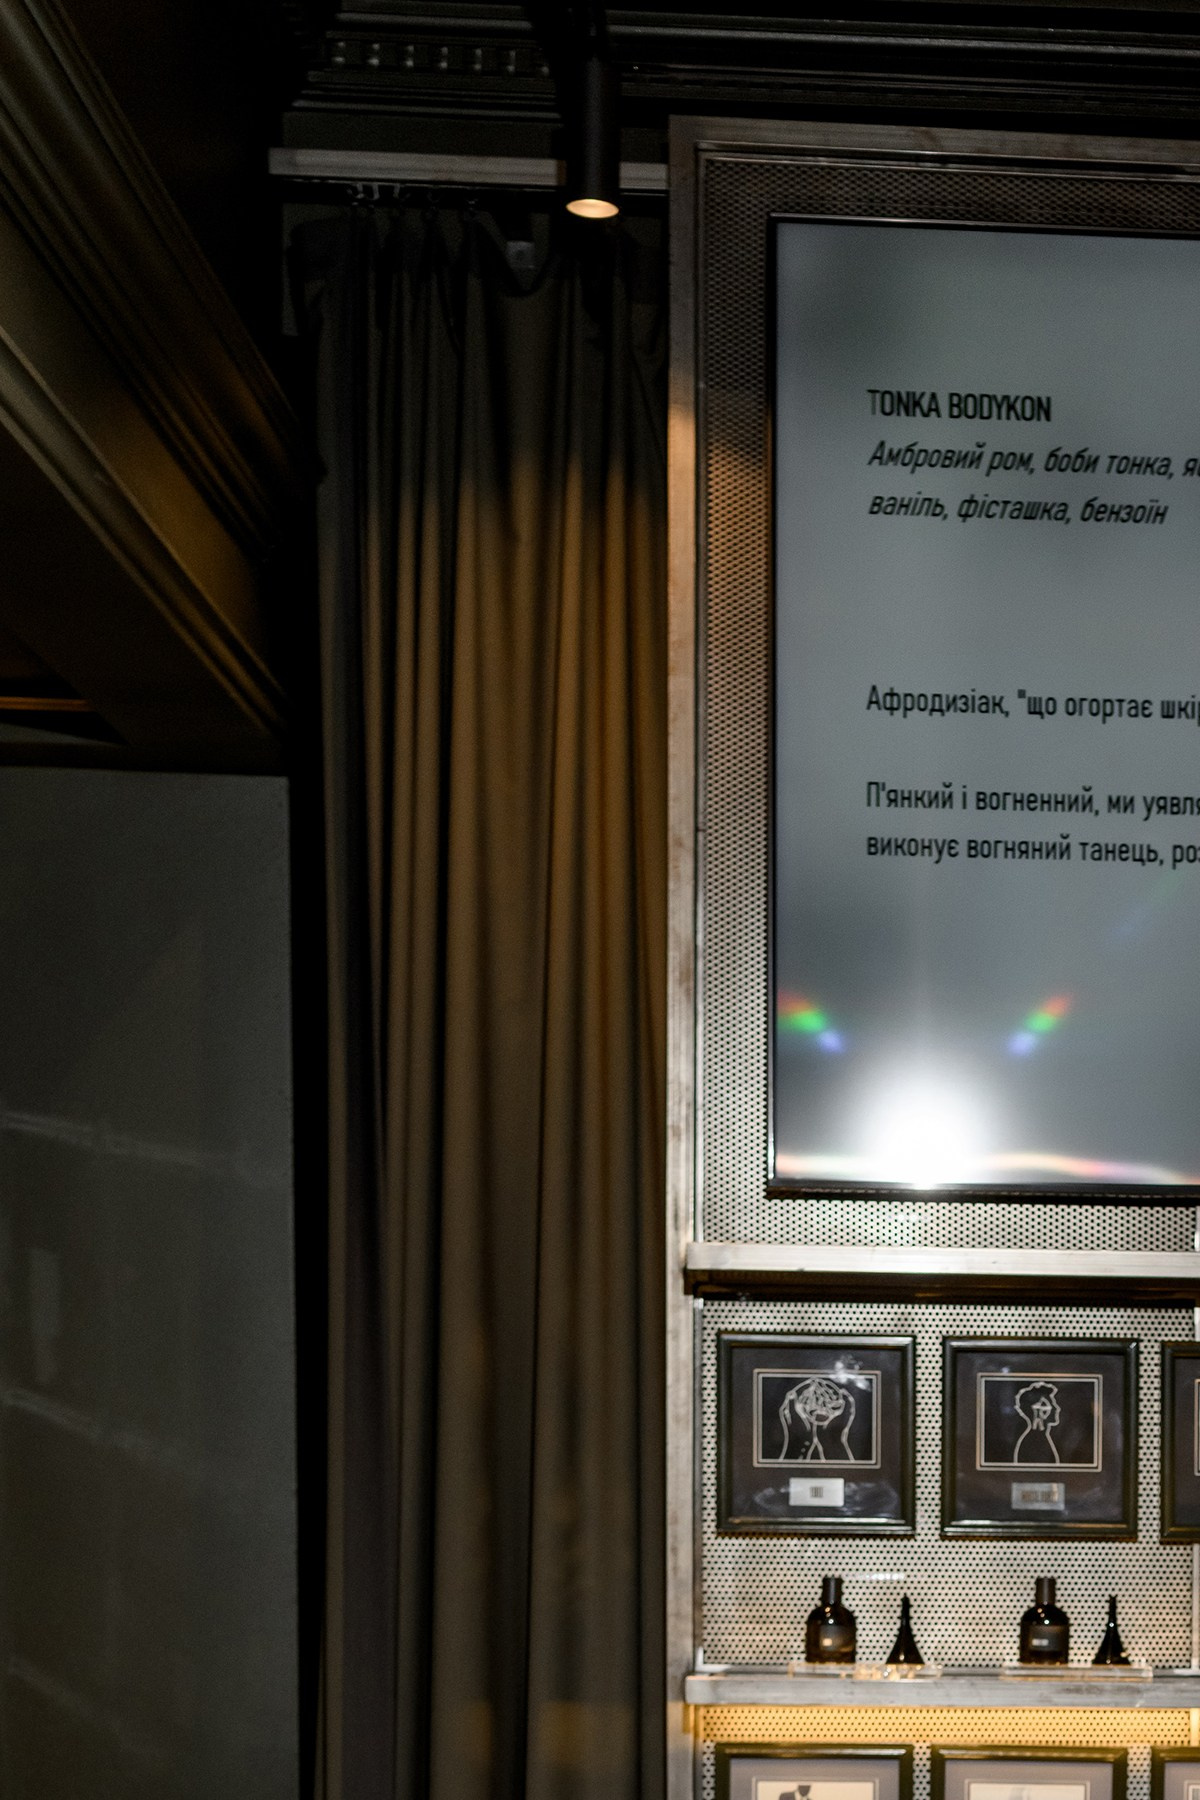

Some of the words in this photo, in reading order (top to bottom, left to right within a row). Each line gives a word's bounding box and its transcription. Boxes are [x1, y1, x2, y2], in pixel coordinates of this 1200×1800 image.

[865, 388, 943, 419] TONKA
[947, 391, 1053, 423] BODYKON
[866, 439, 987, 475] Амбровий
[984, 450, 1036, 478] ром,
[1043, 446, 1101, 474] боби
[1105, 454, 1175, 481] тонка,
[867, 490, 949, 521] ваніль,
[956, 493, 1072, 526] фісташка,
[1079, 495, 1170, 525] бензоїн
[865, 684, 1011, 719] Афродизіак,
[1016, 688, 1058, 720] "що
[1064, 696, 1154, 725] огортає
[866, 780, 954, 810] П'янкий
[962, 785, 967, 809] і
[975, 785, 1100, 817] вогненний,
[1106, 794, 1136, 815] ми
[866, 836, 960, 865] виконує
[966, 832, 1072, 861] вогняний
[1078, 841, 1165, 867] танець,
